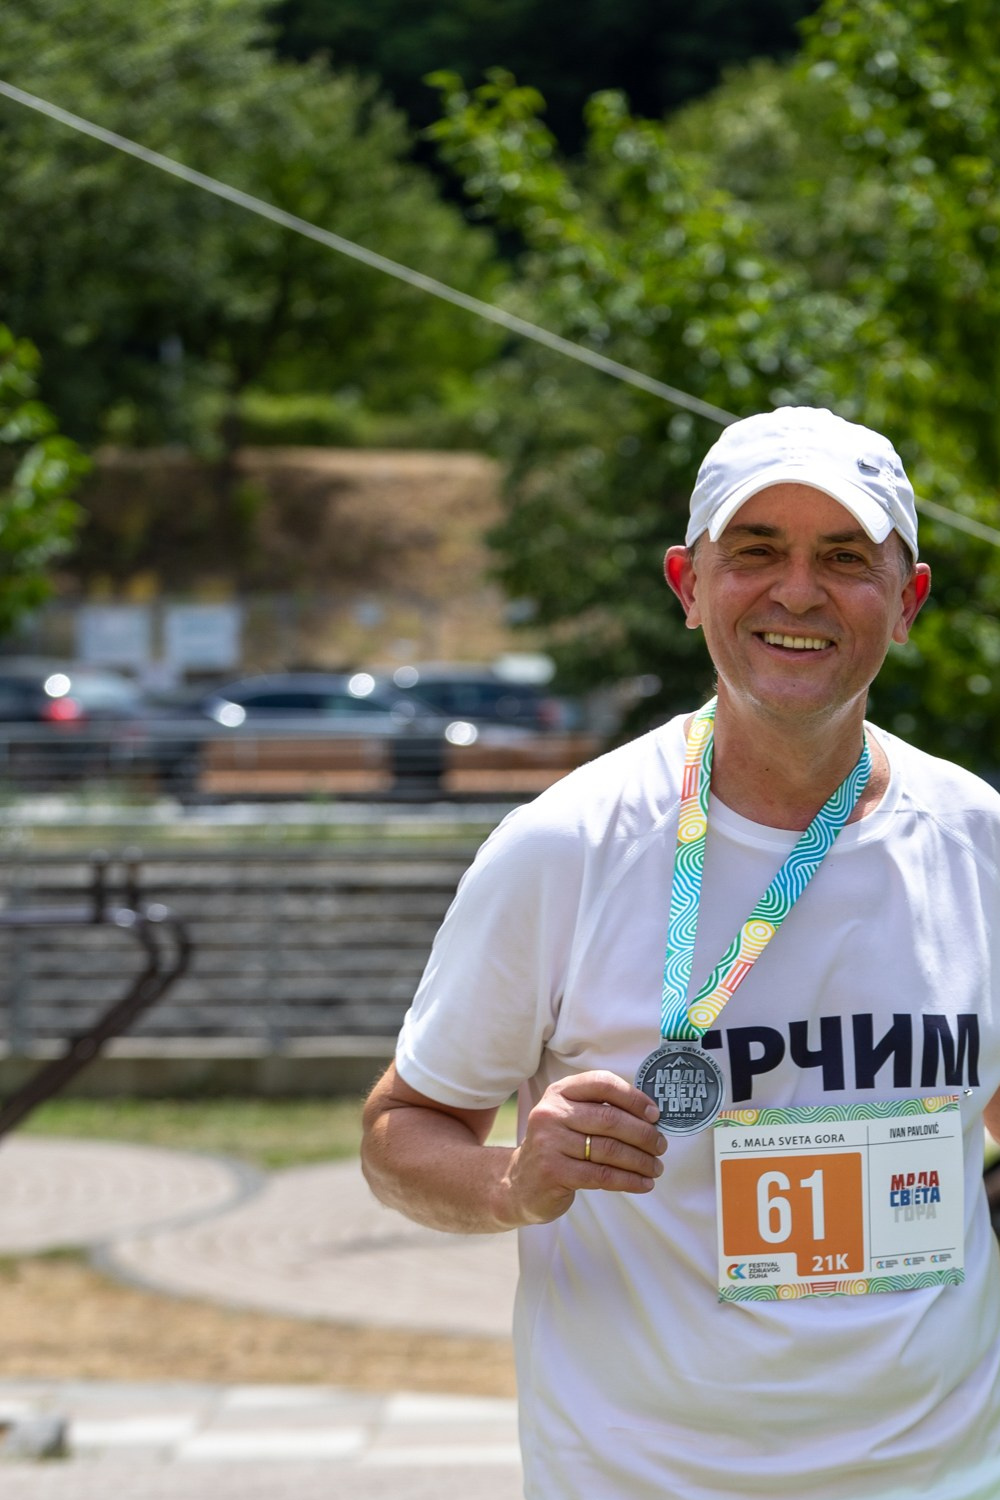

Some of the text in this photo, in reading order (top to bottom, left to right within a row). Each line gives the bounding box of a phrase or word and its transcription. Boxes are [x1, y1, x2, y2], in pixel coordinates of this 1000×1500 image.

[701, 1014, 980, 1103] РЧИМ
[654, 1083, 708, 1098] СВЕТА
[658, 1097, 704, 1112] ГОРА
[889, 1122, 940, 1139] IVAN PAVLOVIĆ
[731, 1133, 845, 1148] 6. MALA SVETA GORA
[889, 1186, 941, 1208] СВЕТА
[757, 1169, 826, 1244] 61
[811, 1253, 849, 1272] 21K
